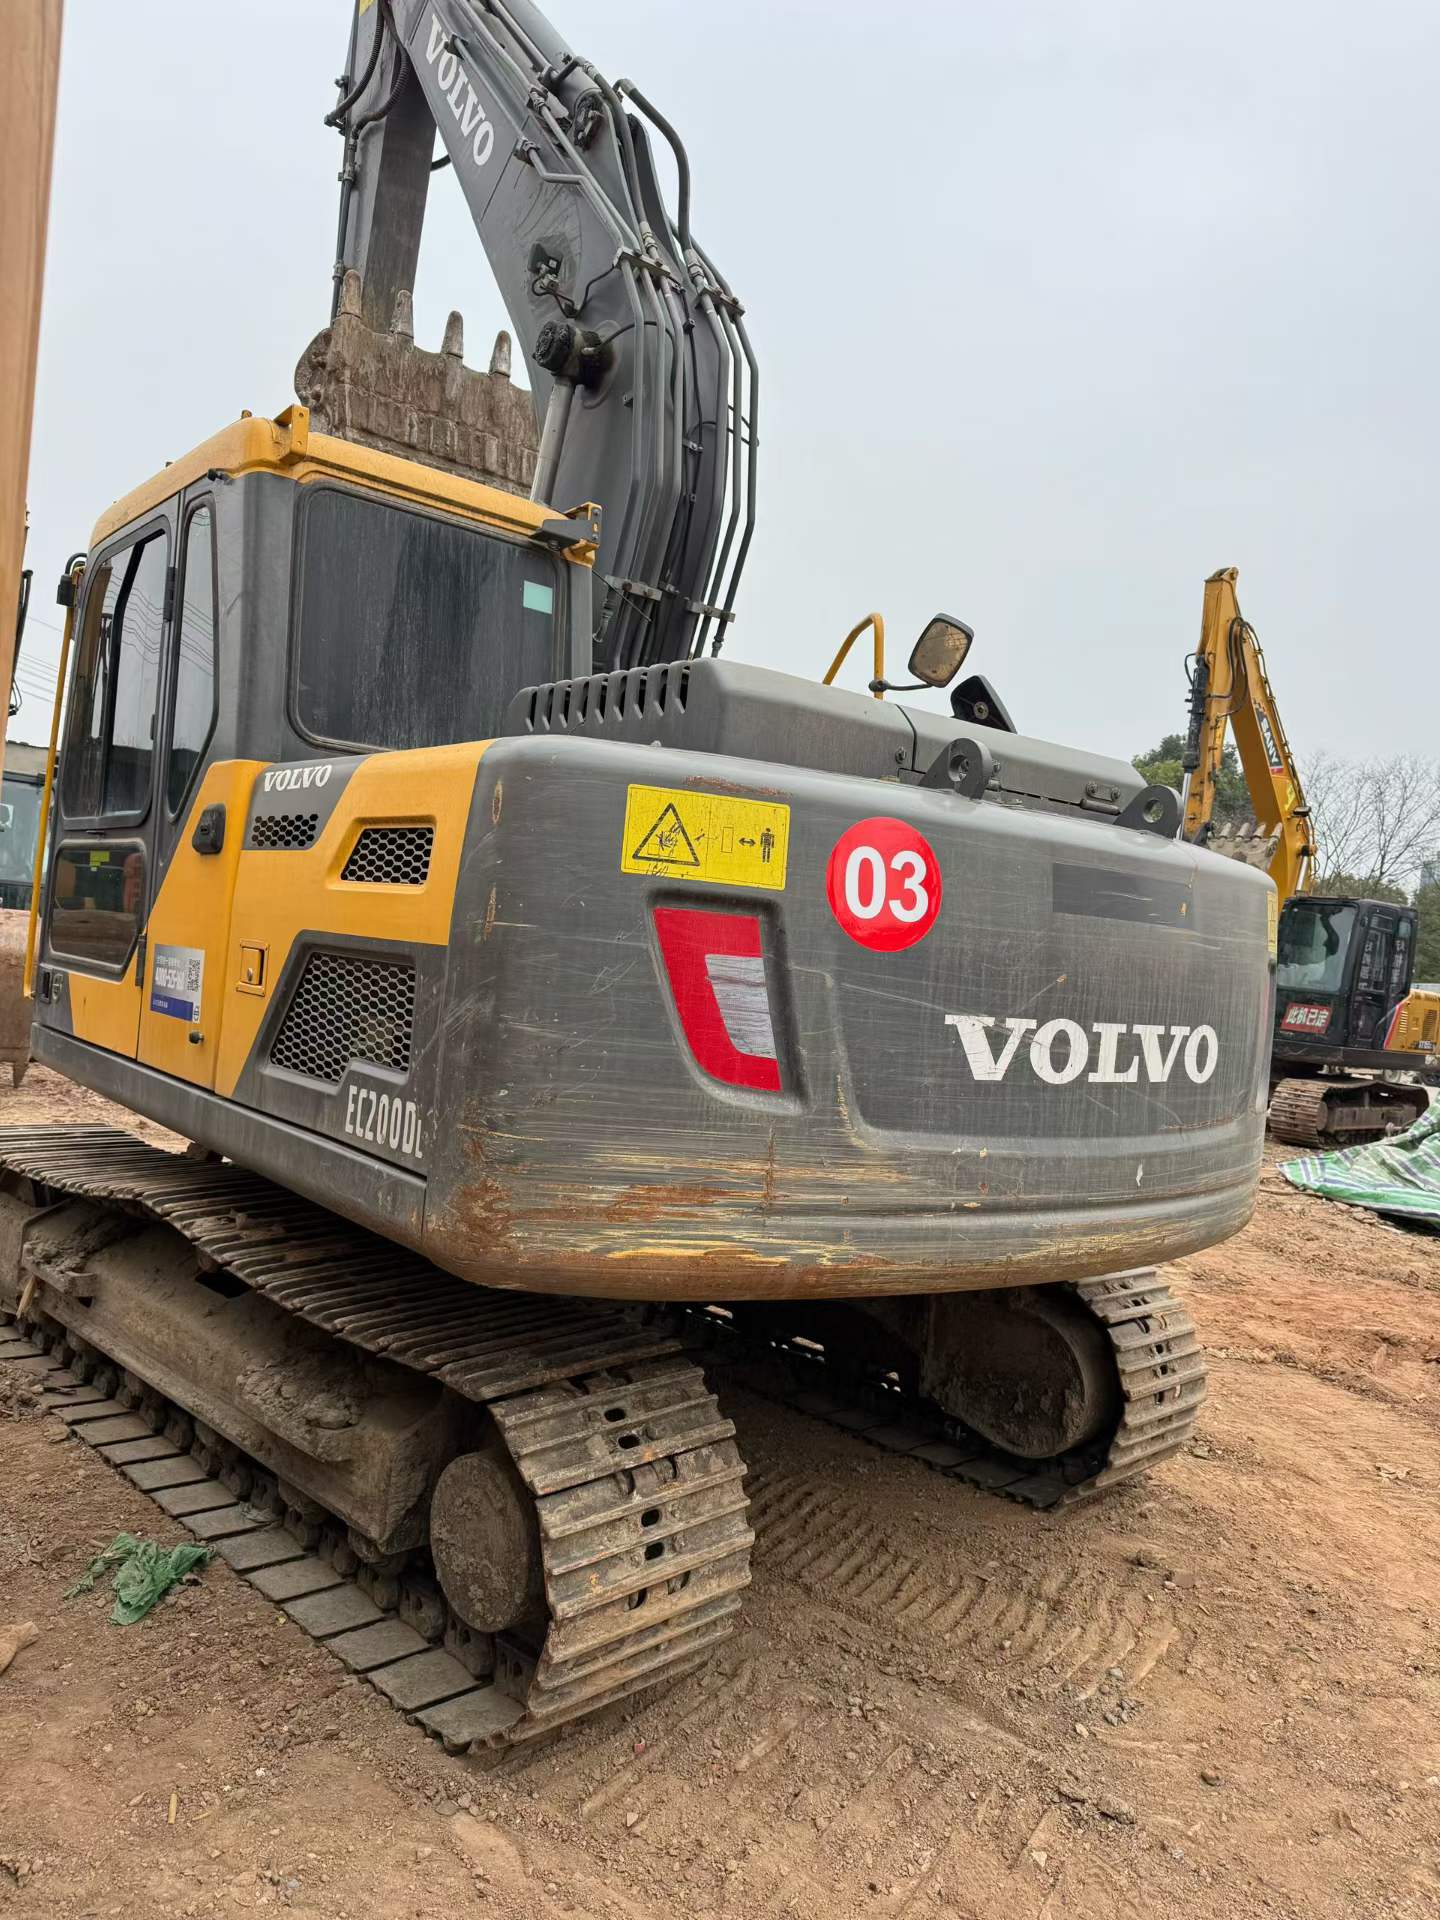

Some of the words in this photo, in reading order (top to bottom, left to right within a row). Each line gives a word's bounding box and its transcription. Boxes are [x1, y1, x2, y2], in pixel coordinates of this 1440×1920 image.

[426, 13, 494, 166] VOLVO
[264, 764, 332, 792] VOLVO
[845, 845, 929, 922] 03
[945, 1014, 1219, 1085] VOLVO
[345, 1084, 423, 1159] EC200DL
